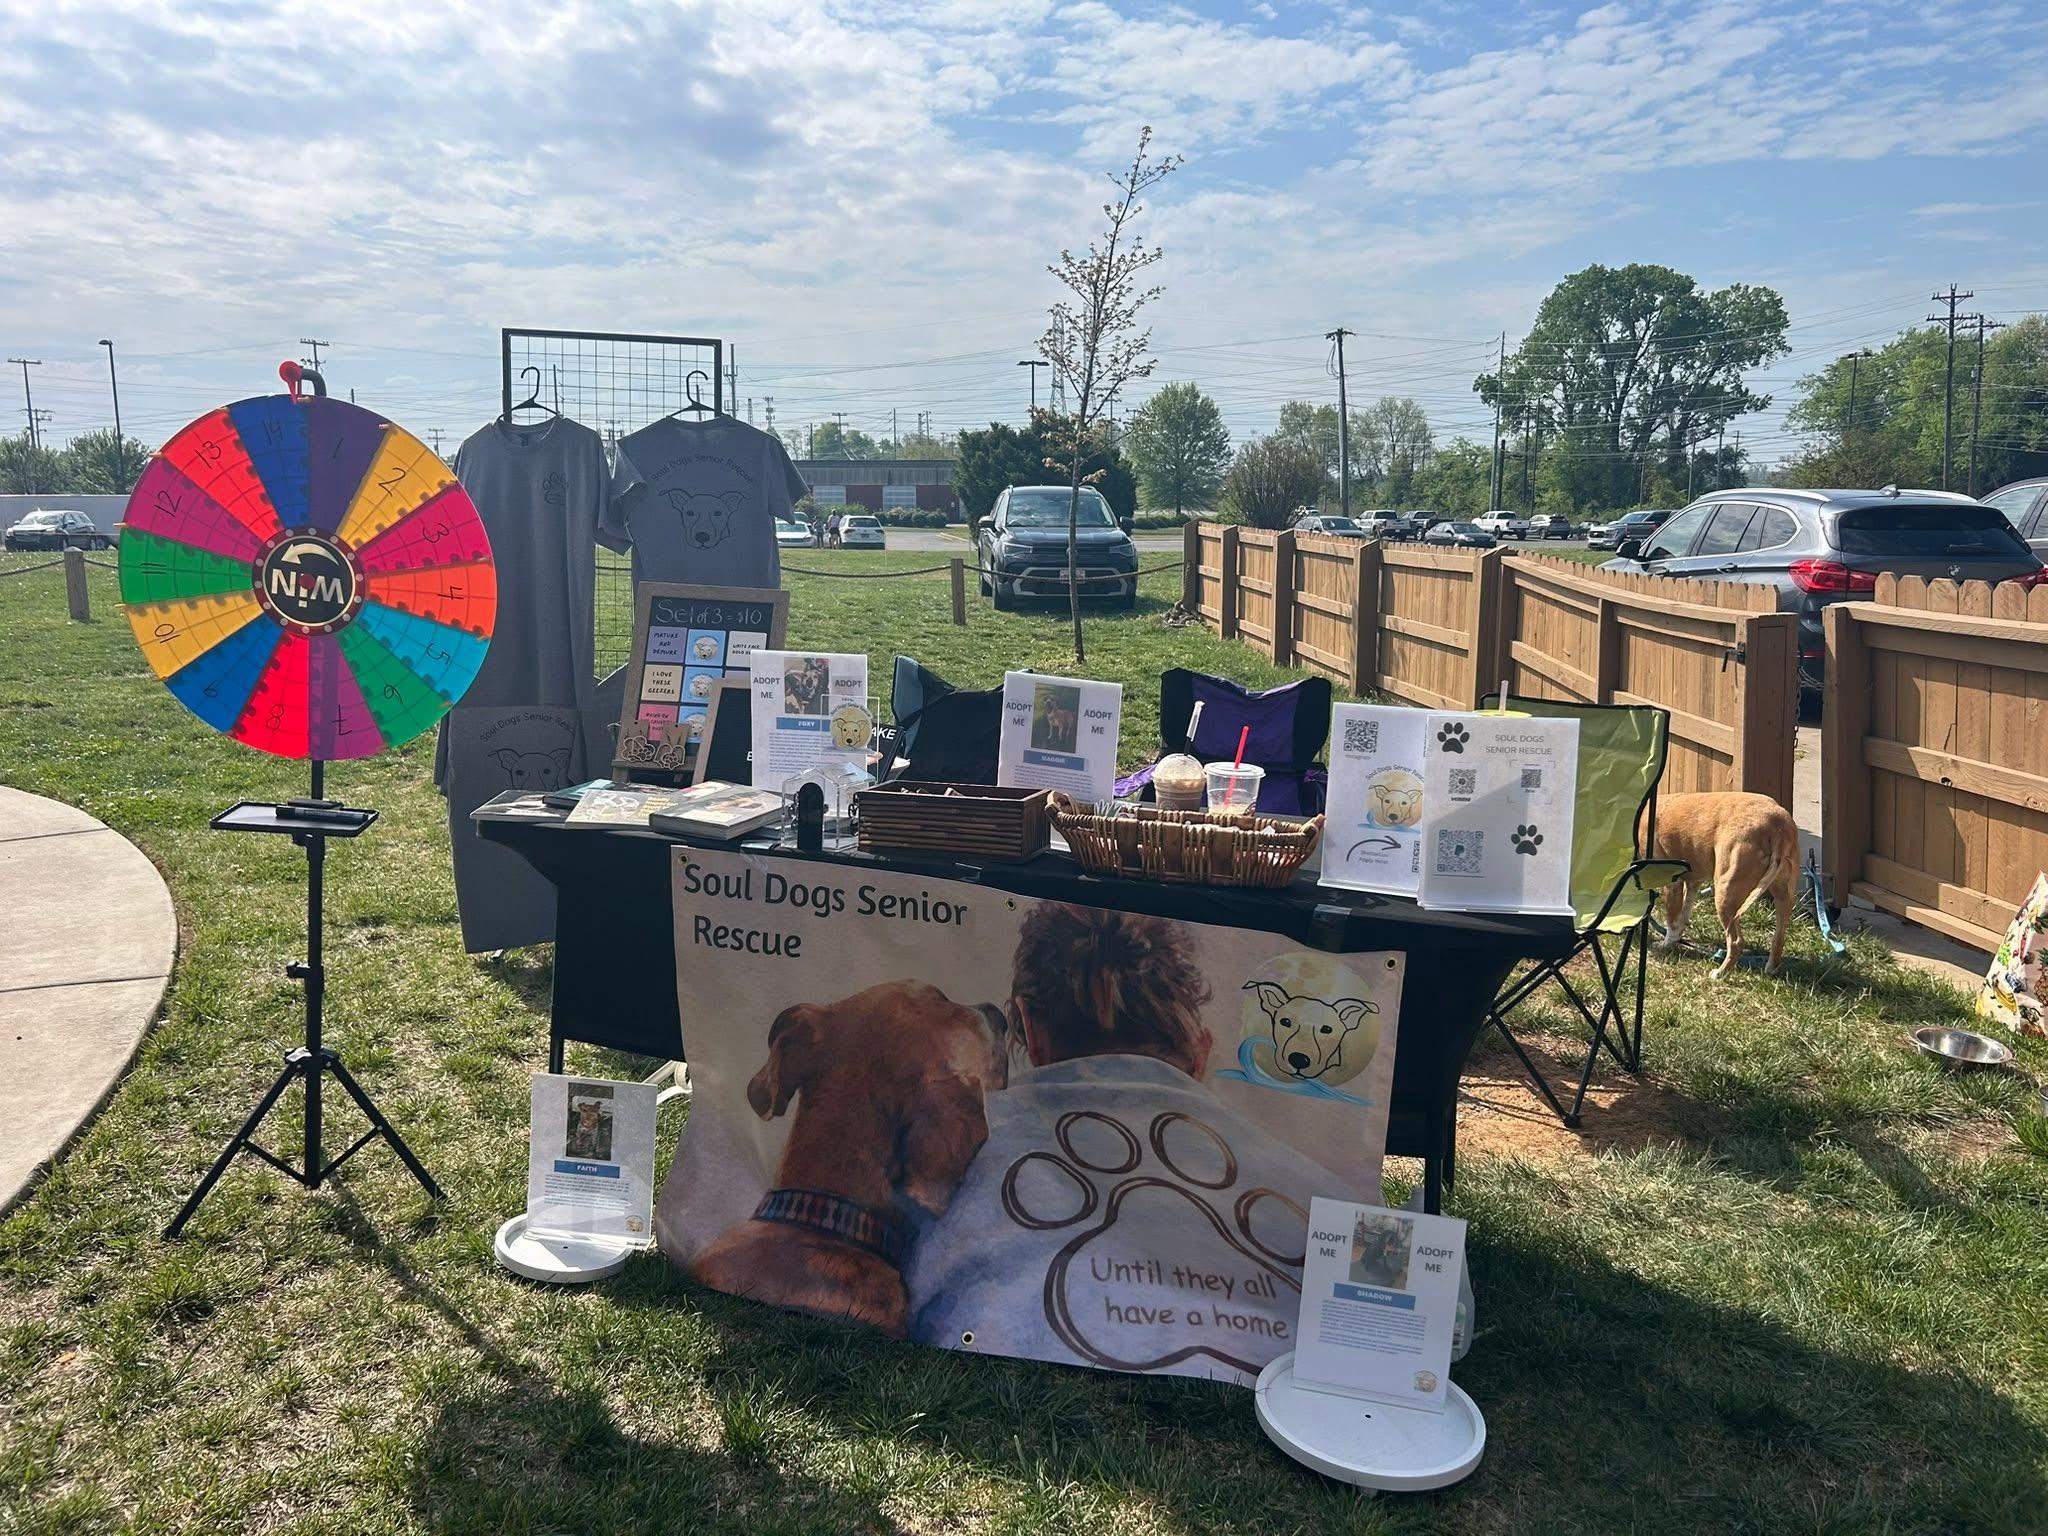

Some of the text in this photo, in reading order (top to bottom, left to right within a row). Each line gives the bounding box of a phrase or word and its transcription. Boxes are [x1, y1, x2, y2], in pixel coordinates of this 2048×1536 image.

[194, 440, 222, 469] 13
[378, 467, 406, 497] 2
[154, 490, 182, 517] 12
[422, 522, 450, 544] 3
[437, 586, 464, 600] 4
[696, 606, 711, 625] of
[711, 607, 723, 624] 3
[154, 623, 179, 644] 10
[425, 643, 452, 665] 5
[753, 676, 780, 685] ADOPT
[834, 678, 862, 689] ADOPT
[760, 690, 774, 700] ME
[1005, 701, 1032, 712] ADOPT
[496, 715, 521, 730] Dogs
[521, 711, 553, 722] Senior
[1012, 717, 1025, 727] ME
[1083, 709, 1113, 720] ADOPT
[1090, 725, 1105, 735] ME
[1494, 734, 1545, 743] SOUL DOGS
[1485, 746, 1553, 755] SENIOR RESCUE
[683, 862, 968, 926] Soul Dogs Senior
[694, 914, 801, 958] Rescue
[1311, 1230, 1348, 1245] ADOPT
[1319, 1247, 1337, 1258] ME
[1416, 1245, 1454, 1260] ADOPT
[1424, 1262, 1442, 1273] ME
[1090, 1257, 1277, 1300] Until they all
[1356, 1289, 1393, 1301] SHADOW
[1104, 1296, 1175, 1326] have
[1186, 1309, 1201, 1326] a
[1212, 1303, 1290, 1340] home
